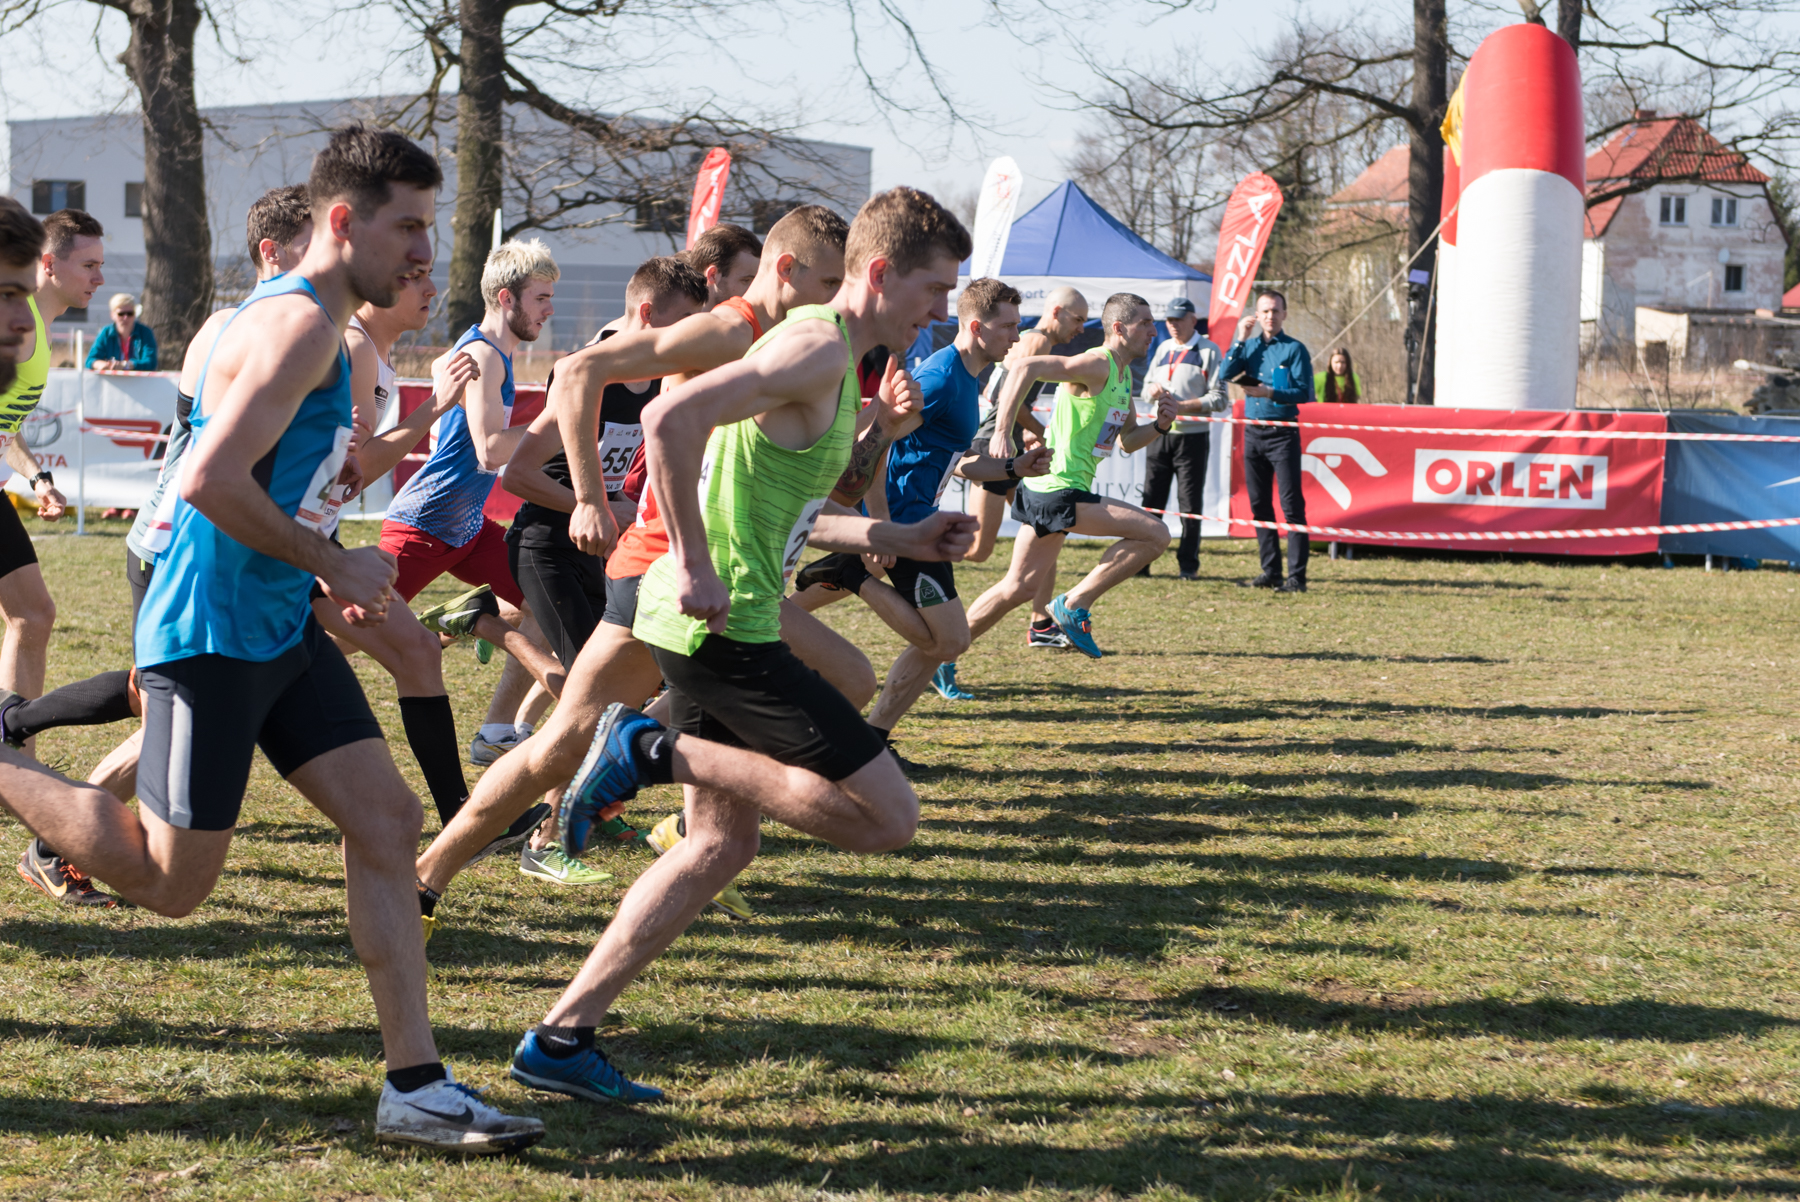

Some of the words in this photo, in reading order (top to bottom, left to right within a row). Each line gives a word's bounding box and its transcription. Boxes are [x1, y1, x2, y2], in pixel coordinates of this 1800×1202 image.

[1218, 192, 1273, 309] PZLA
[34, 453, 68, 468] OTA
[1425, 458, 1594, 500] ORLEN
